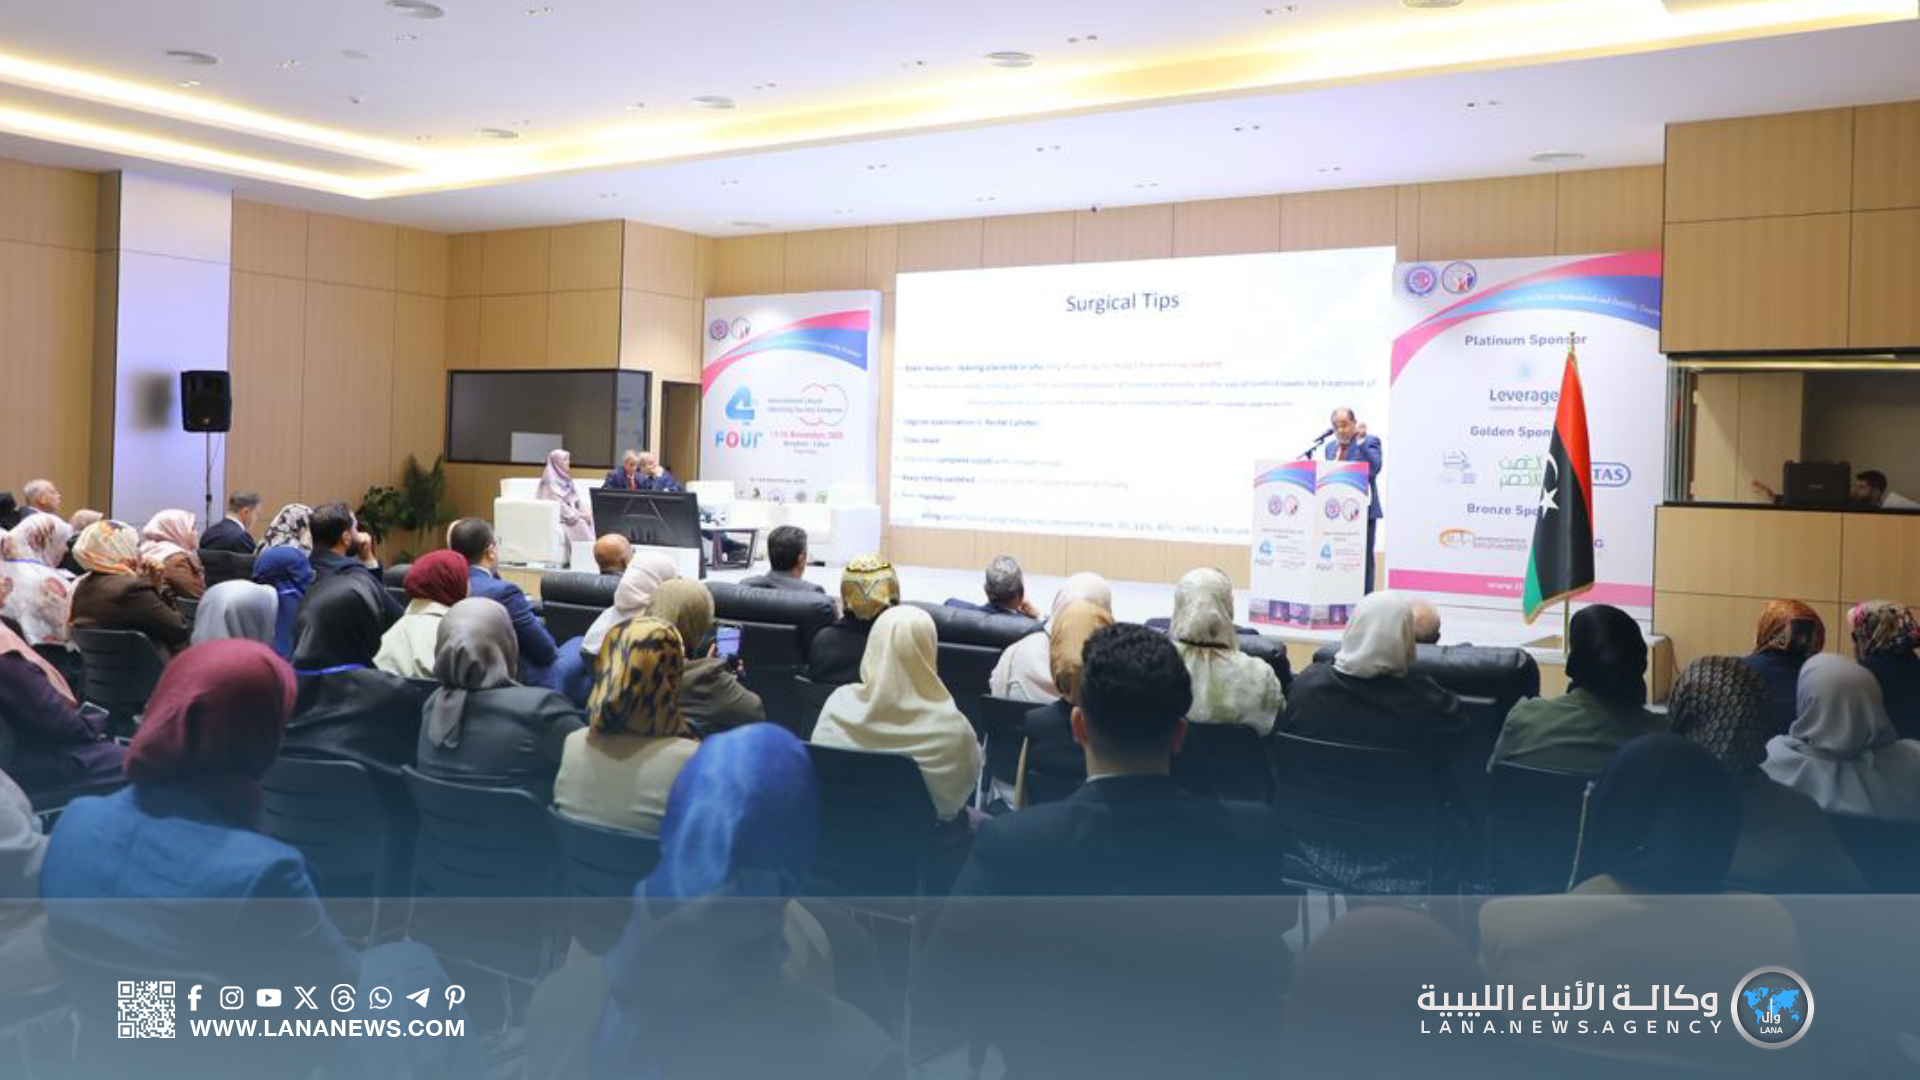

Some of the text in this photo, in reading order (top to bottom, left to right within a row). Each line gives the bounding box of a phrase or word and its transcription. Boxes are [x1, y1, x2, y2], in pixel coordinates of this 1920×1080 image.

[1066, 292, 1180, 315] Surgical Tips
[1465, 335, 1526, 346] Platinum
[726, 386, 755, 420] 4
[1489, 389, 1560, 405] Leverage
[1470, 426, 1550, 439] Golden Spon
[1593, 468, 1625, 481] TAS
[1467, 503, 1512, 515] Bronze
